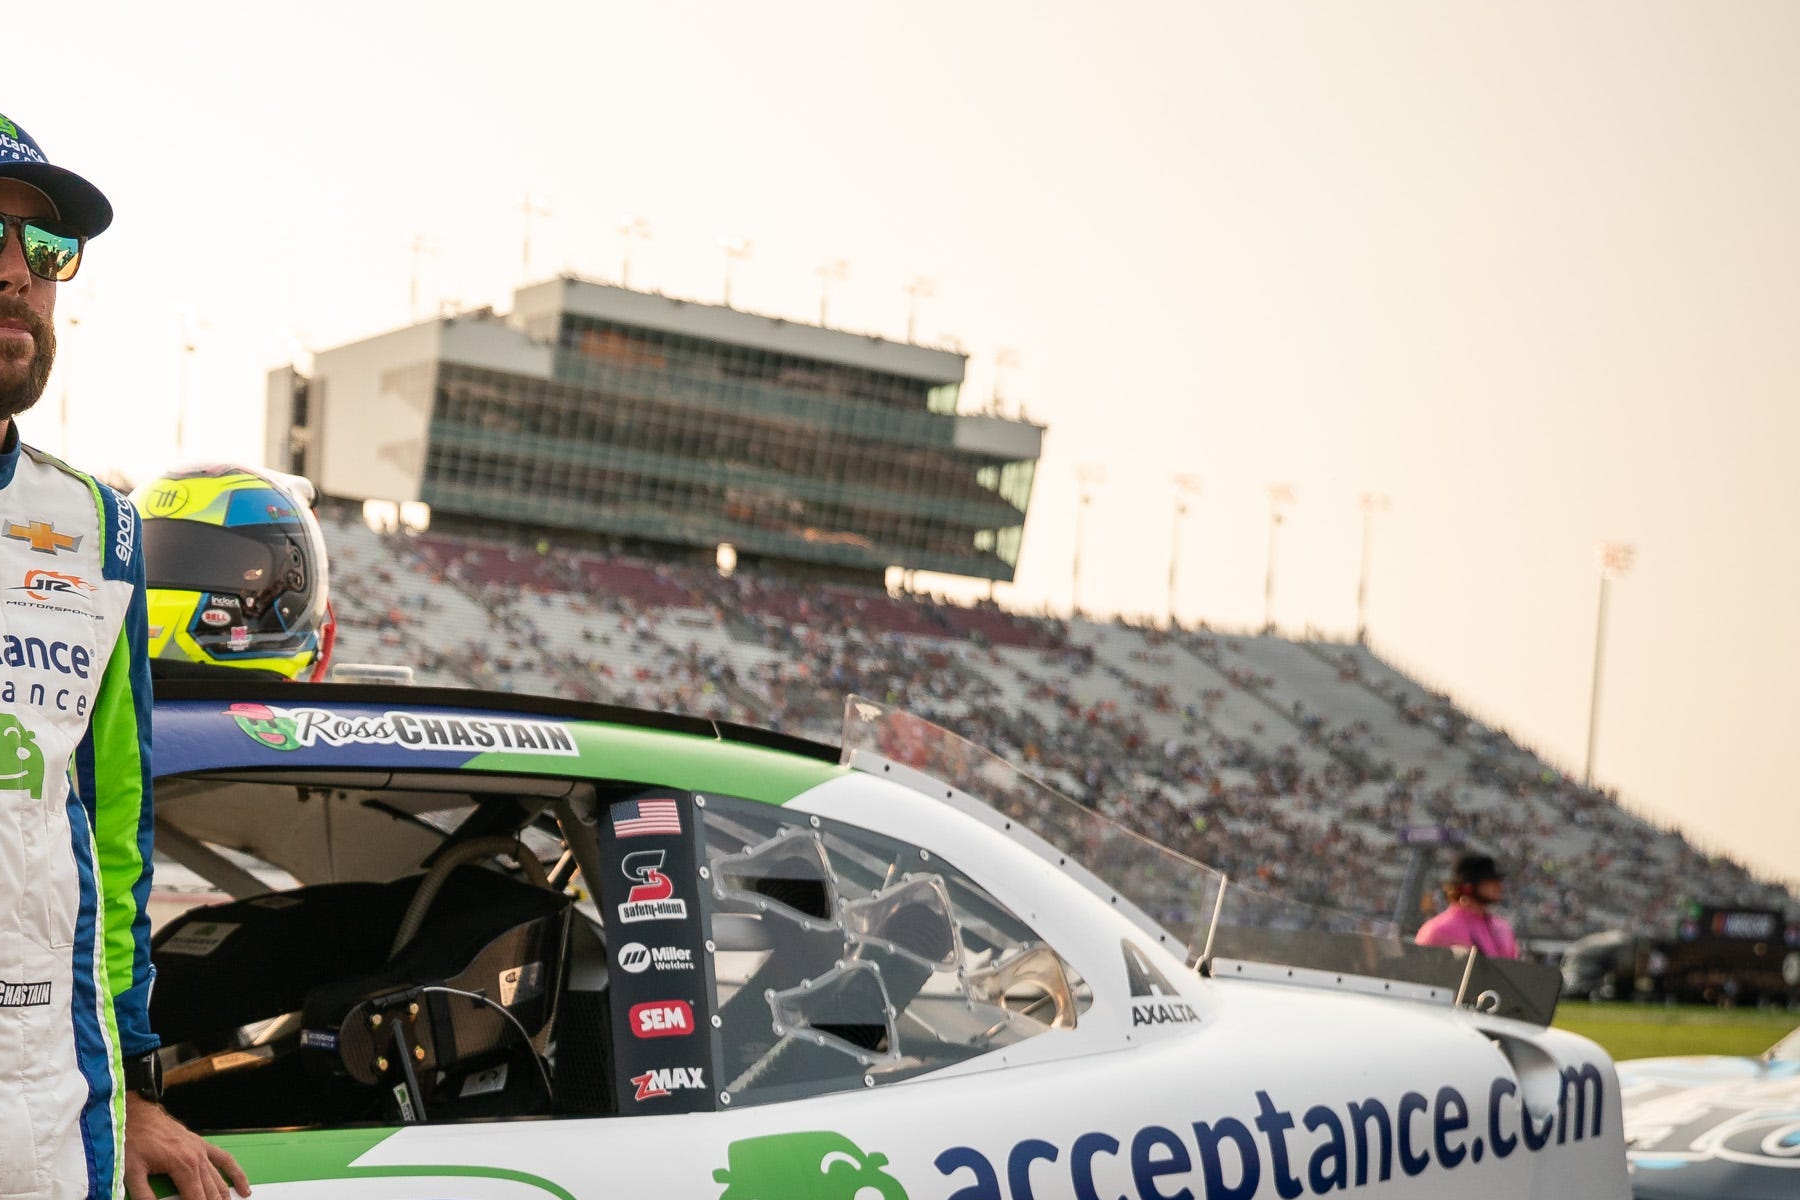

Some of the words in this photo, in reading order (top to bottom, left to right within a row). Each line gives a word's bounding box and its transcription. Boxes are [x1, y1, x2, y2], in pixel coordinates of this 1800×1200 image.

[6, 600, 105, 620] MOTORSPORTS
[295, 711, 398, 742] Ross
[391, 713, 575, 751] CHASTAIN
[623, 901, 685, 918] safety-kleen
[651, 946, 691, 961] Miller
[654, 960, 695, 971] Welders
[638, 1006, 687, 1032] SEM
[1132, 1002, 1203, 1027] AXALTA
